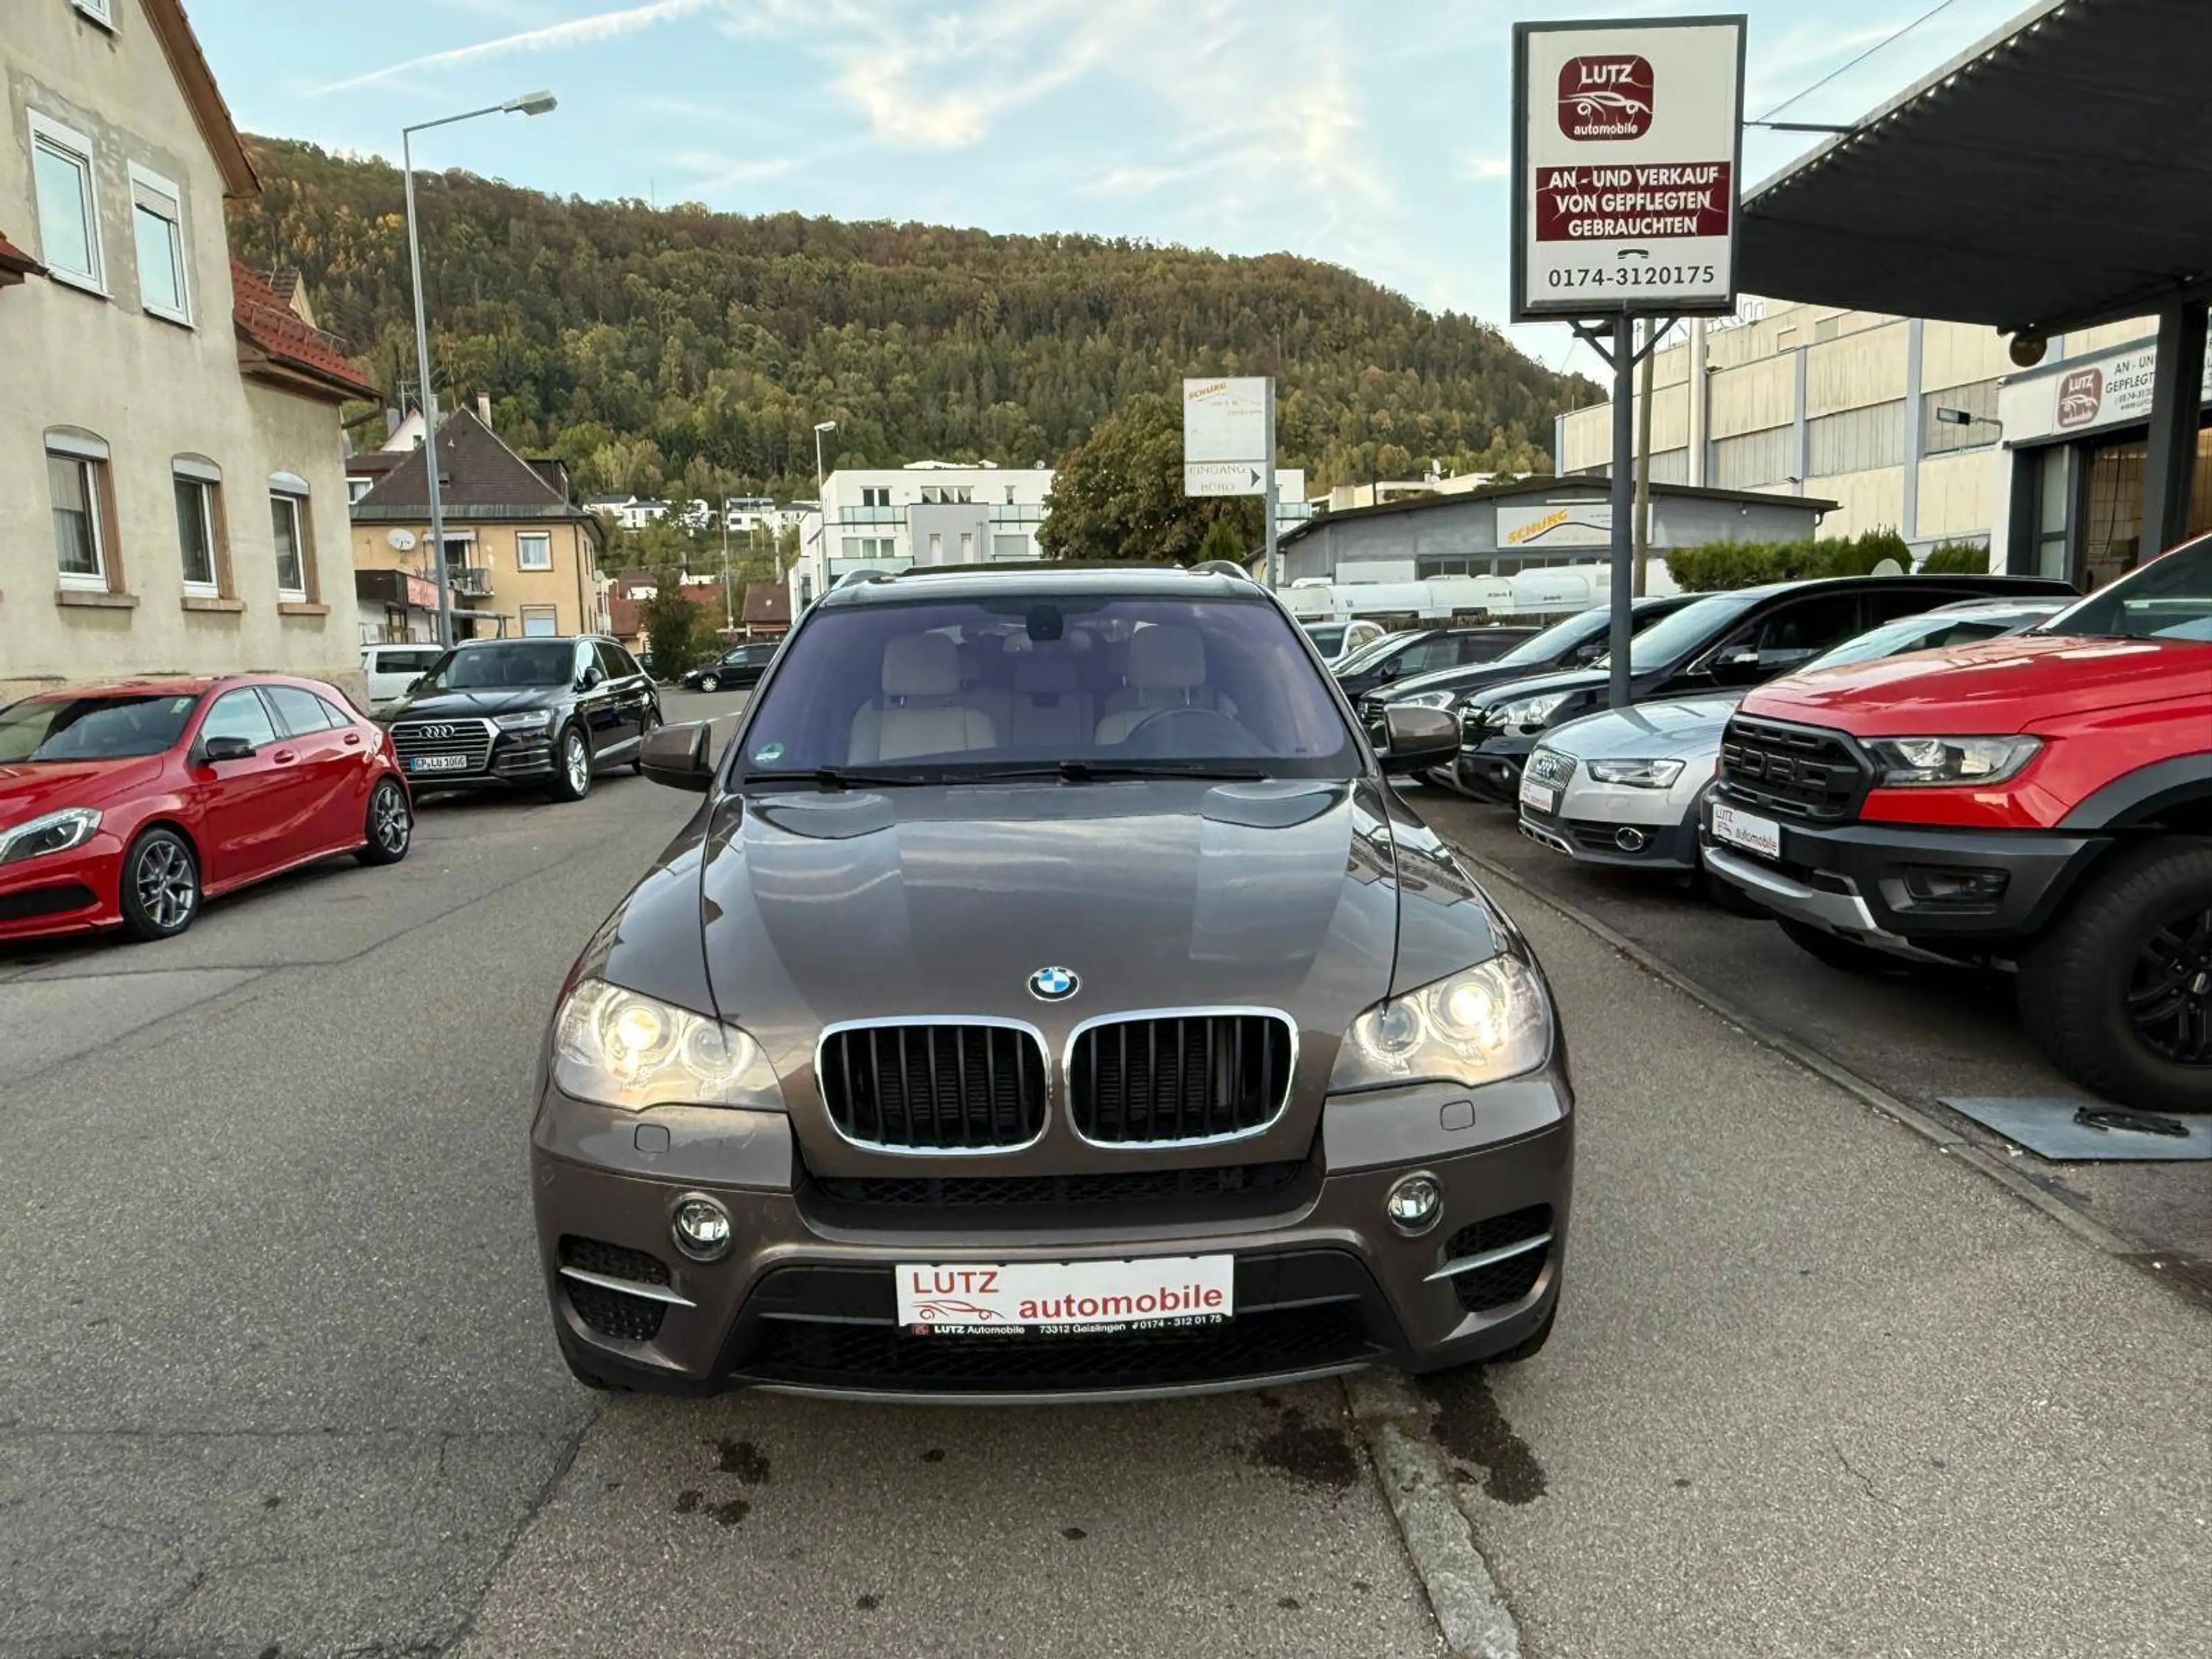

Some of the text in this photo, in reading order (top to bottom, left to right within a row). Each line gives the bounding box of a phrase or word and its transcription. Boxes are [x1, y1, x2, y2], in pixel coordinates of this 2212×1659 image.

[1581, 65, 1633, 84] LUTZ
[1574, 123, 1638, 135] automobile
[1548, 171, 1577, 188] AN
[1592, 169, 1632, 187] UND
[1636, 166, 1719, 185] VERKAUF
[1555, 191, 1711, 213] VON GEPFLEGTEN
[1568, 217, 1698, 236] GEBRAUCHTEN
[1548, 266, 1715, 287] 0174-3120175
[2069, 374, 2094, 391] LUTZ
[913, 1272, 999, 1293] LUTZ
[1018, 1284, 1222, 1320] automobile
[934, 1325, 965, 1334] LUTZ
[967, 1325, 1025, 1334] Automobile
[1040, 1325, 1070, 1334] 73312
[1073, 1323, 1126, 1334] Geislingen
[1140, 1319, 1164, 1329] 0174
